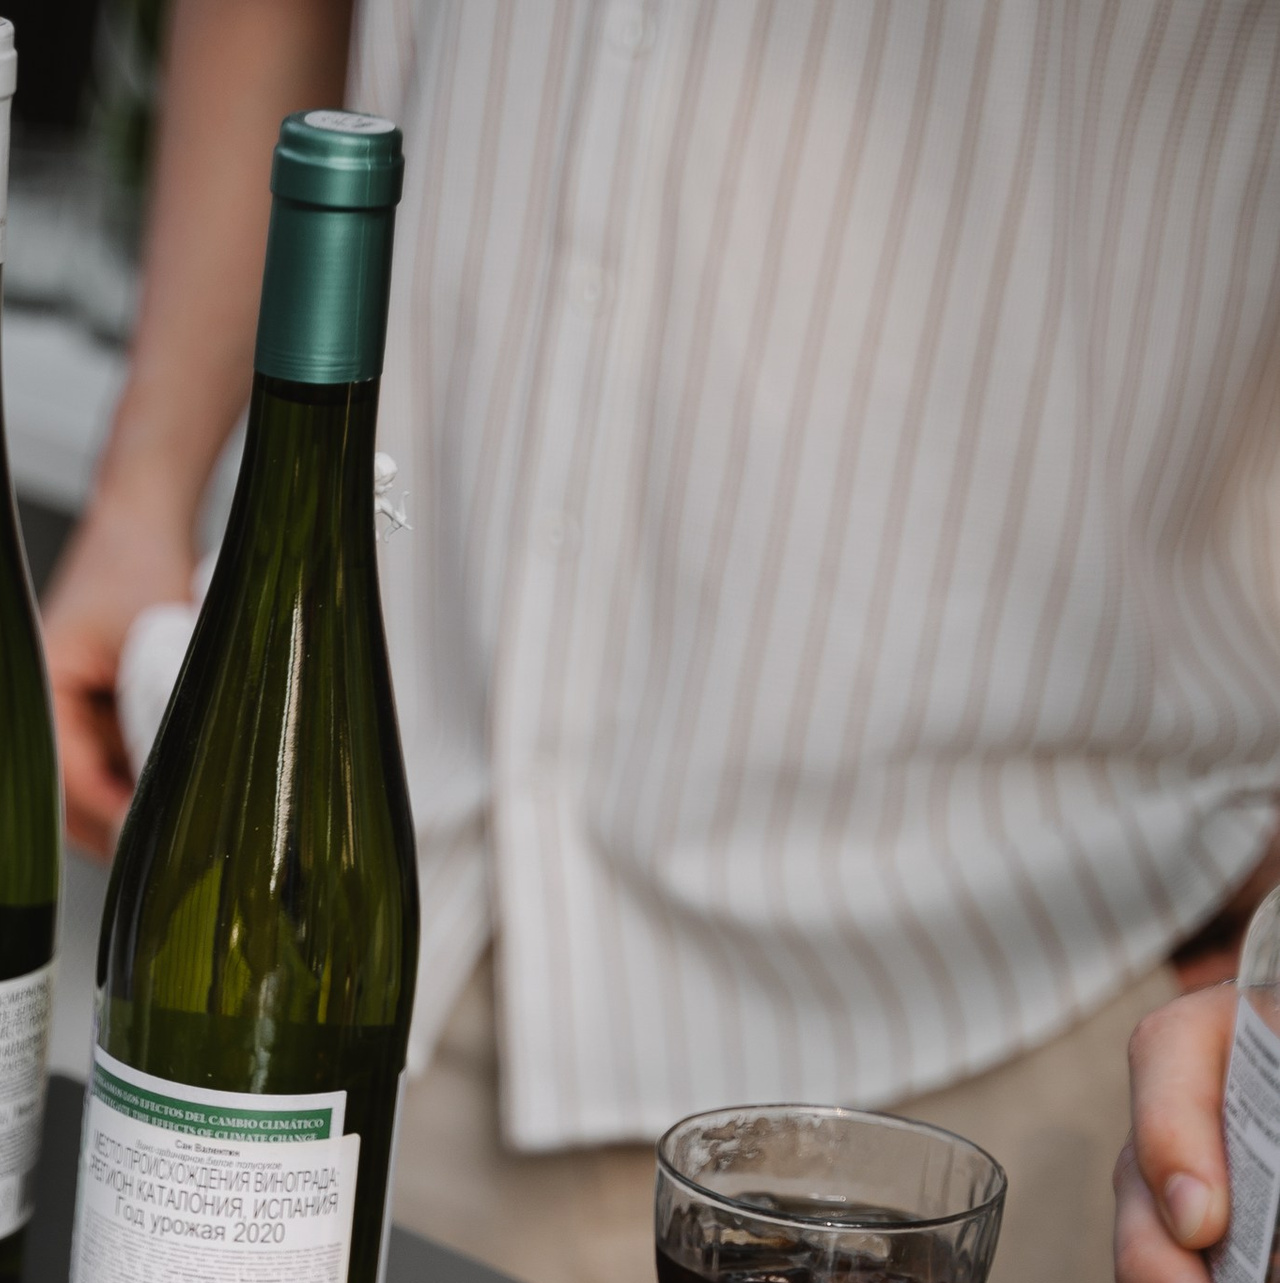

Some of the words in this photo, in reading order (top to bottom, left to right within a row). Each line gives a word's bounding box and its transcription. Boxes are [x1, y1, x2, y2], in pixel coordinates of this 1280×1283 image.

[185, 1110, 207, 1124] DEL
[208, 1115, 258, 1129] CAMBIO
[259, 1117, 325, 1130] CLIMÁTICO
[215, 1130, 269, 1143] CLIMATE
[125, 1146, 251, 1193] ПРОИСХОЖДЕНИЯ
[254, 1166, 340, 1193] ВИНОГРАДА:
[236, 1159, 283, 1171] полусухое
[137, 1180, 247, 1221] КАТАЛОНИЯ,
[253, 1192, 339, 1219] ИСПАНИЯ
[115, 1194, 145, 1229] Год
[150, 1213, 226, 1241] урожая
[233, 1221, 286, 1244] 2020
